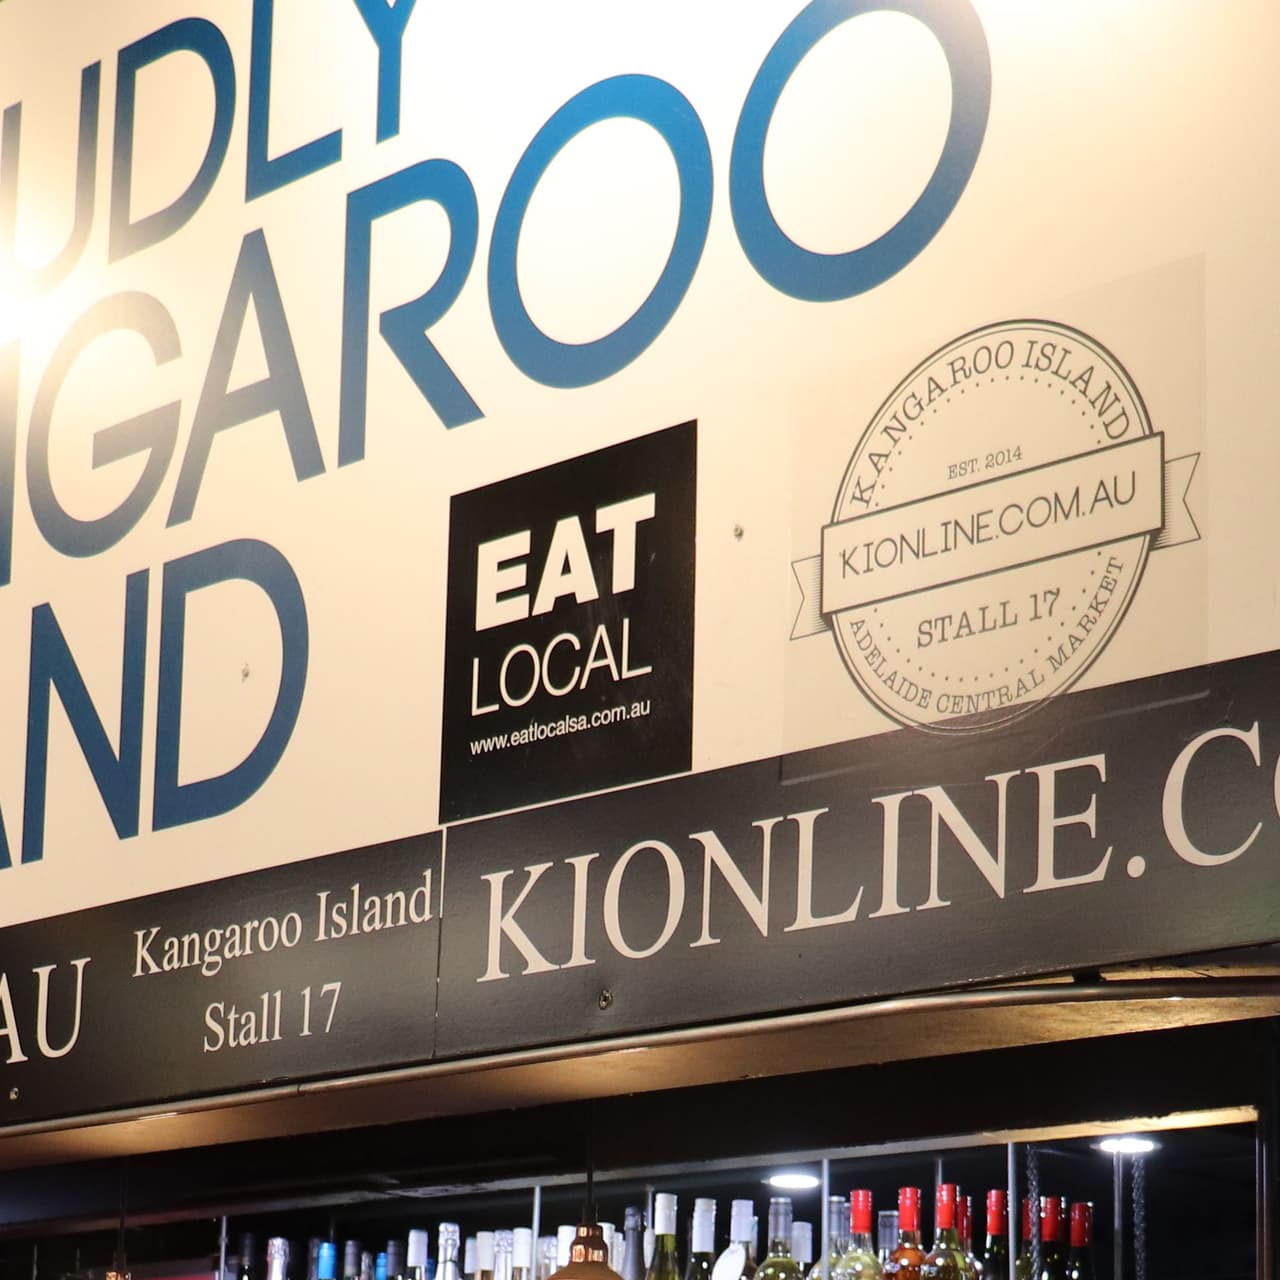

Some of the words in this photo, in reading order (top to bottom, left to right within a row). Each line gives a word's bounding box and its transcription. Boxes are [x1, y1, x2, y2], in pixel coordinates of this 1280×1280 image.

[851, 340, 1015, 509] KANGAROO
[1022, 341, 1130, 441] ISLAND
[947, 459, 981, 480] EST.
[984, 446, 1024, 472] 2014
[477, 493, 655, 630] EAT
[839, 471, 1138, 579] KIONLINE.COM.AU
[472, 622, 652, 715] LOCAL
[849, 617, 934, 711] ADELAIDE
[935, 667, 1045, 714] CENTRAL
[1047, 555, 1126, 675] MARKET
[917, 602, 1019, 649] STALL
[1028, 588, 1061, 623] 17
[469, 699, 652, 757] www.eatlocalsa.com.au
[132, 900, 304, 981] Kangaroo
[315, 867, 433, 943] Island
[203, 988, 282, 1056] Stall
[294, 980, 342, 1042] 17
